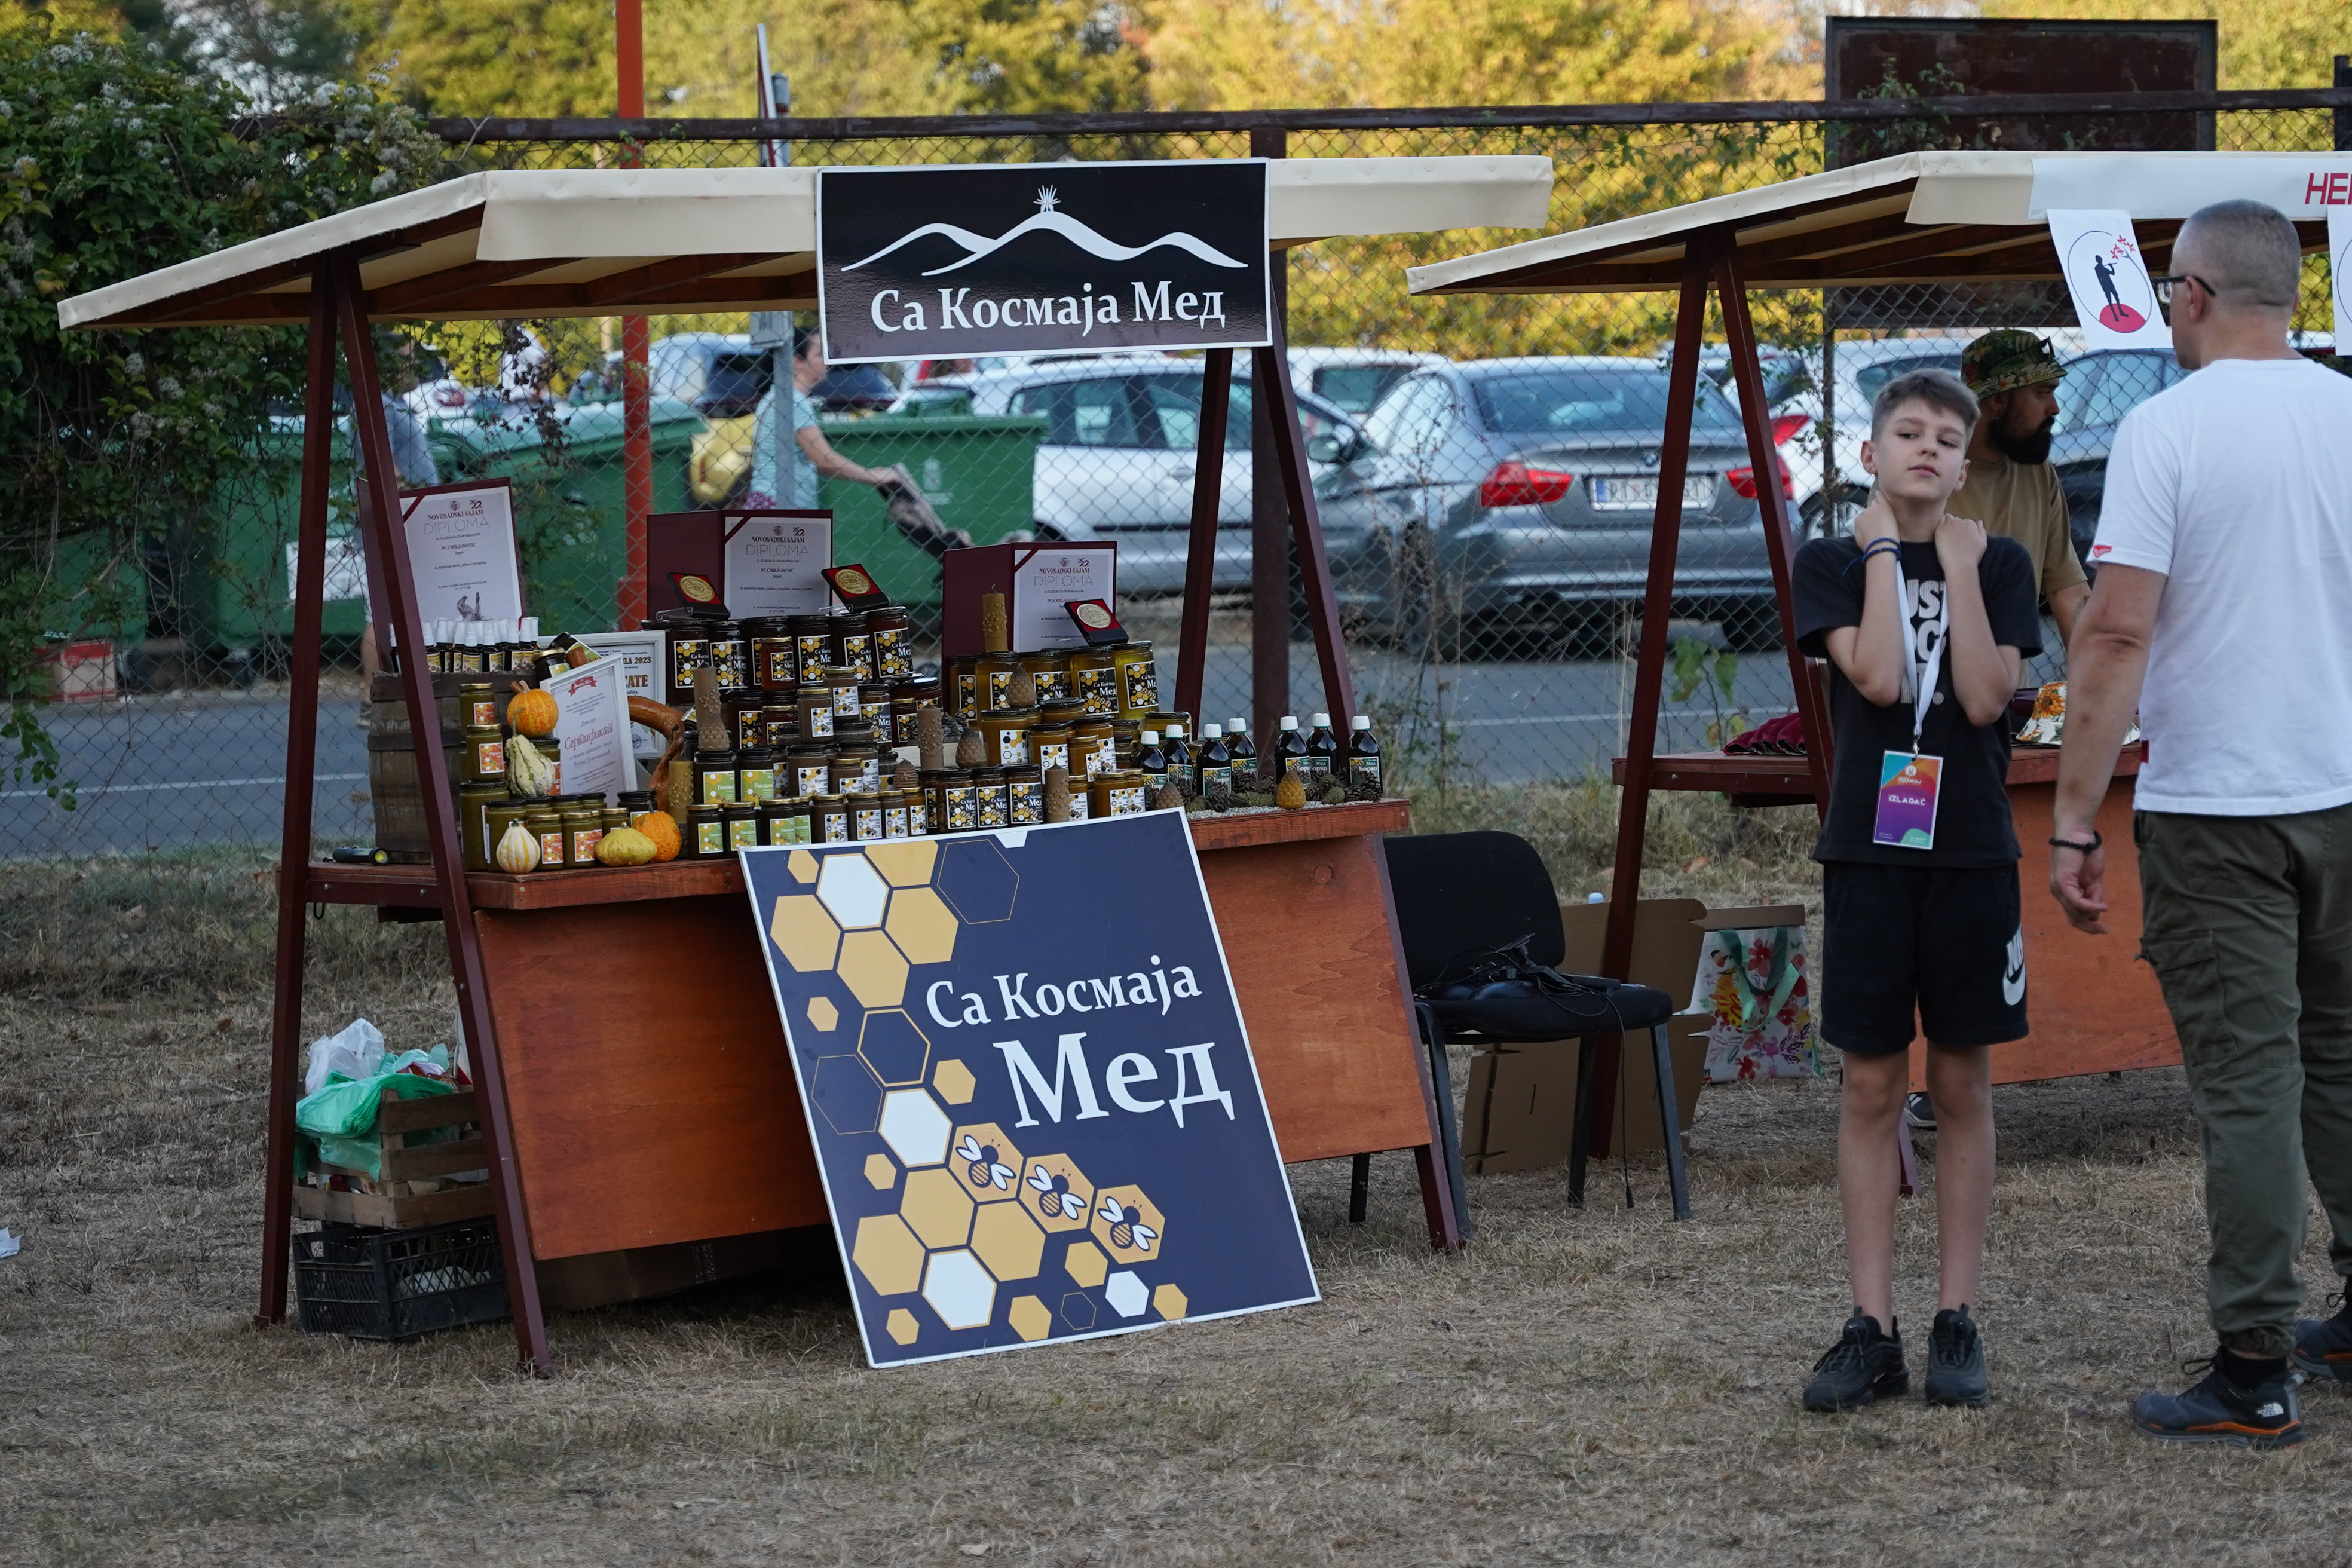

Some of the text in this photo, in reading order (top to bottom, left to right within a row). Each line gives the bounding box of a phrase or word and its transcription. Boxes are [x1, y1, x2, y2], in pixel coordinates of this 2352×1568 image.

[871, 281, 1225, 336] Са Космаја Мед
[428, 509, 484, 520] NOVOSADSKI SAJAM
[424, 517, 490, 535] DIPLOMA
[746, 544, 810, 556] DIPLOMA
[1034, 575, 1094, 587] DIPLOMA
[634, 656, 651, 664] 2023
[625, 675, 648, 688] ATE
[565, 722, 613, 751] Сертификат
[1888, 795, 1927, 806] IZLAGAČ
[926, 955, 1202, 1027] Са Космаја
[993, 1032, 1235, 1129] Мед
